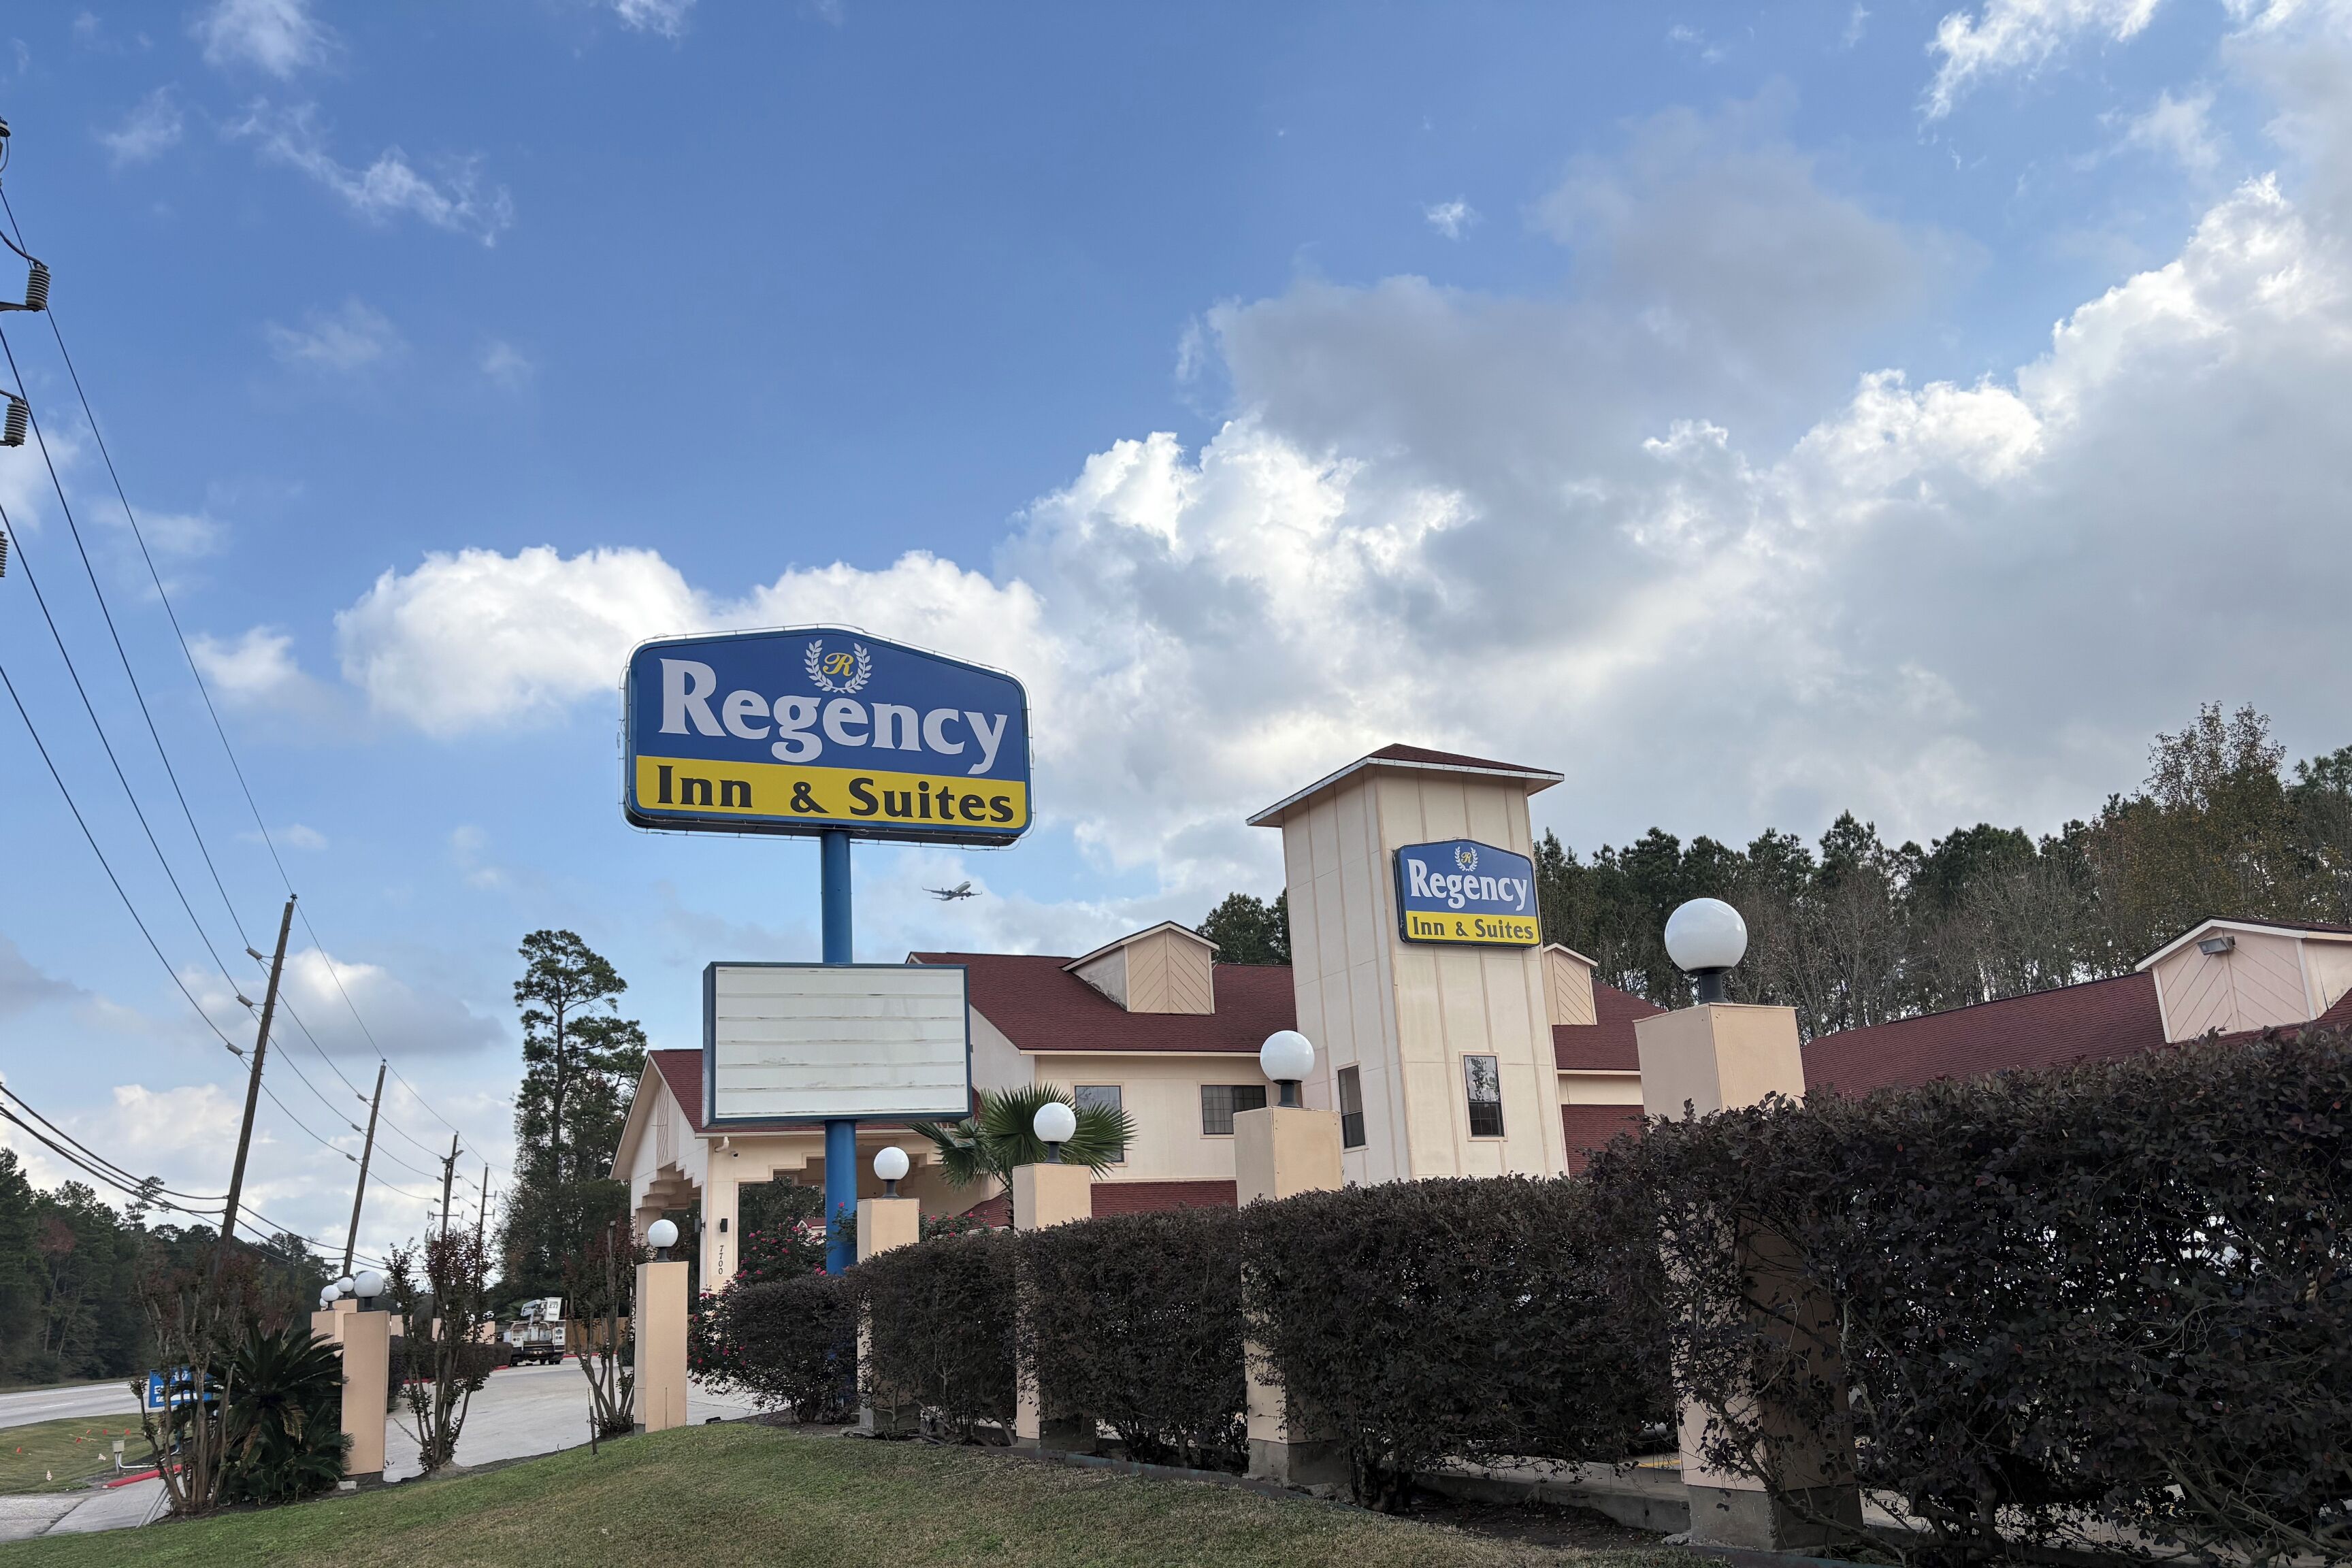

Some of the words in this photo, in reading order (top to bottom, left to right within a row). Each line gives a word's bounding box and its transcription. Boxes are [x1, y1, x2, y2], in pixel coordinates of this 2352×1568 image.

[823, 652, 854, 677] R
[658, 657, 1008, 774] Regency
[657, 765, 753, 808] Inn
[790, 781, 829, 814] &
[848, 777, 1014, 823] Suites
[1461, 851, 1472, 864] R
[1407, 858, 1527, 911] Regency
[1412, 916, 1445, 936] Inn
[1456, 921, 1469, 937] &
[1474, 919, 1534, 939] Suites
